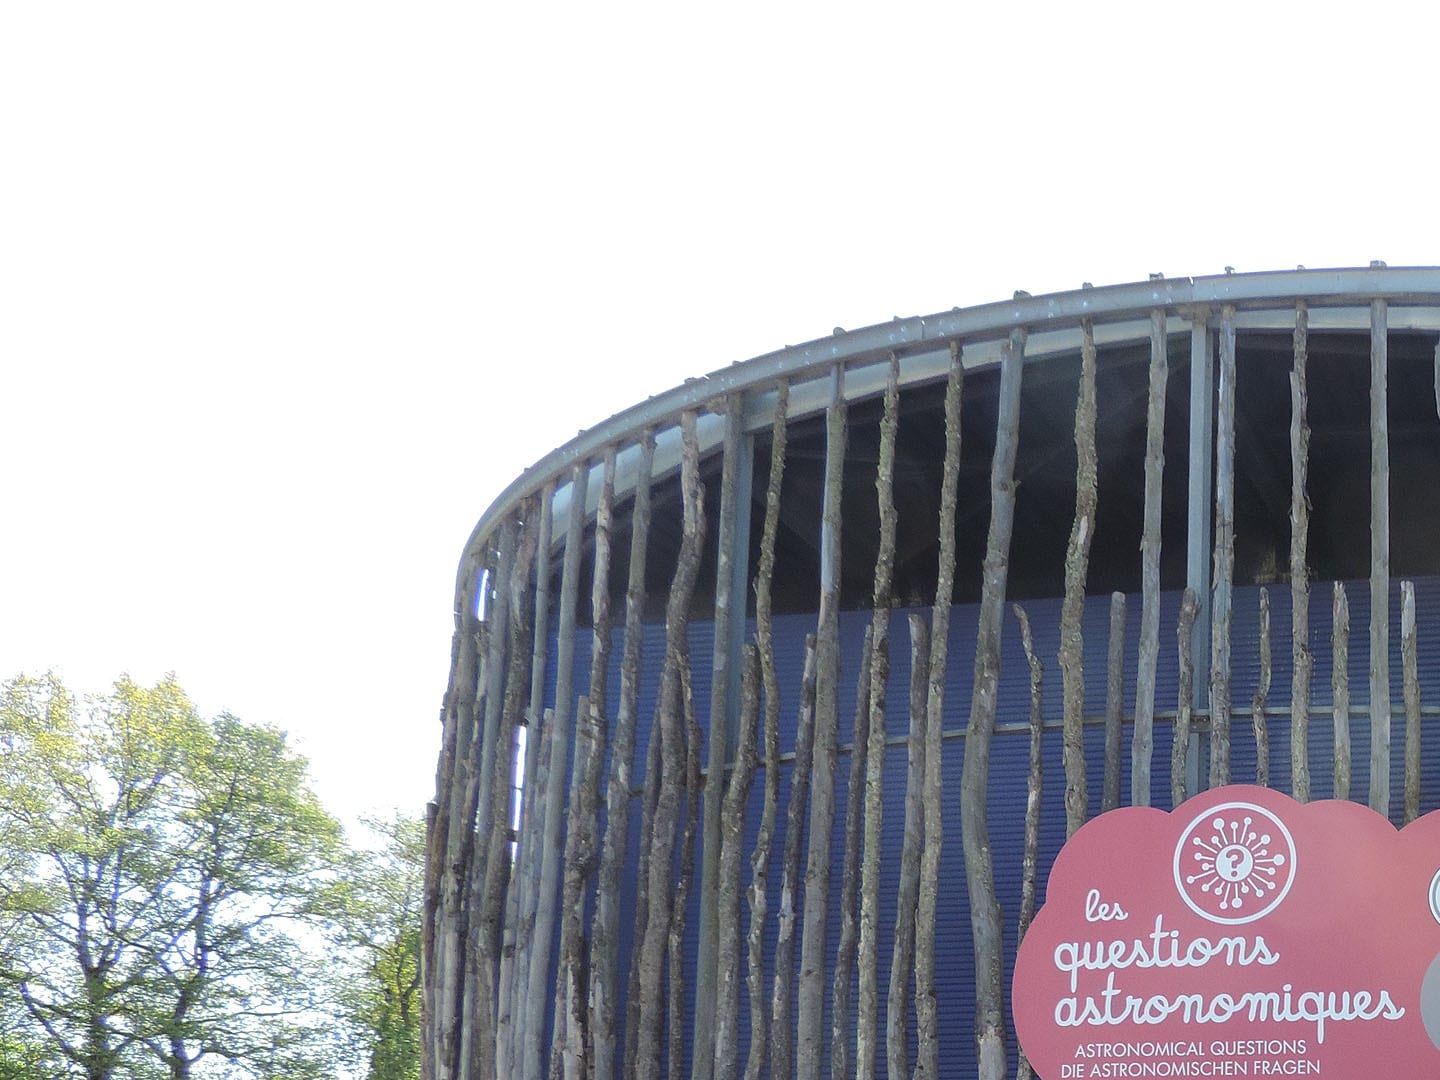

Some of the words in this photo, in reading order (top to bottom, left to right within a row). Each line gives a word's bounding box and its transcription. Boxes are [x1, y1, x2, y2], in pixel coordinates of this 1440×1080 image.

[1085, 889, 1128, 922] les
[1054, 914, 1280, 993] questions
[1054, 971, 1405, 1044] astronomiques
[1074, 1042, 1205, 1059] ASTRONOMICAL
[1210, 1039, 1307, 1058] QUESTIONS
[1061, 1063, 1084, 1079] DIE
[1089, 1061, 1247, 1078] ASTRONOMISCHEN
[1253, 1059, 1321, 1076] FRAGEN
